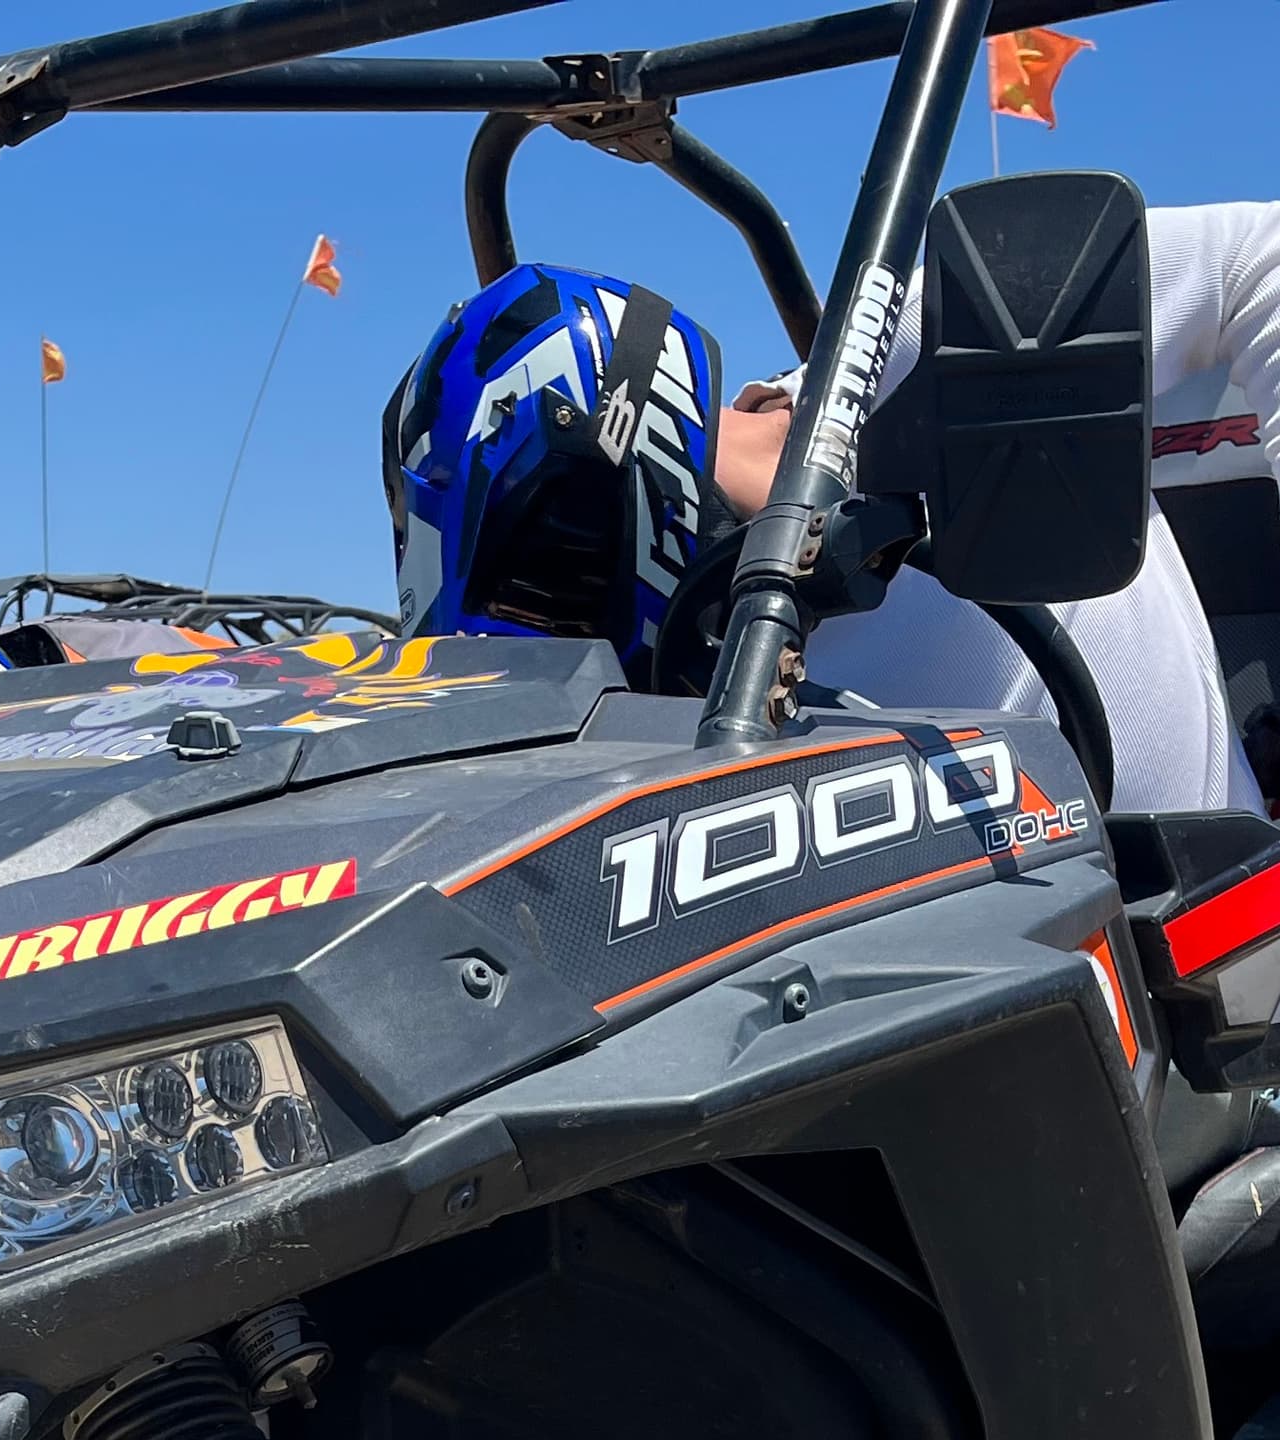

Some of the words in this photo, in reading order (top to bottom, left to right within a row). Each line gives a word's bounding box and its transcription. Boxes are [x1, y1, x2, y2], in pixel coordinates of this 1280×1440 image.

[811, 264, 896, 473] METHOD
[866, 281, 906, 399] WHEELS
[1151, 412, 1262, 460] ZR
[603, 734, 1019, 942] 1000
[985, 798, 1088, 855] DOHC
